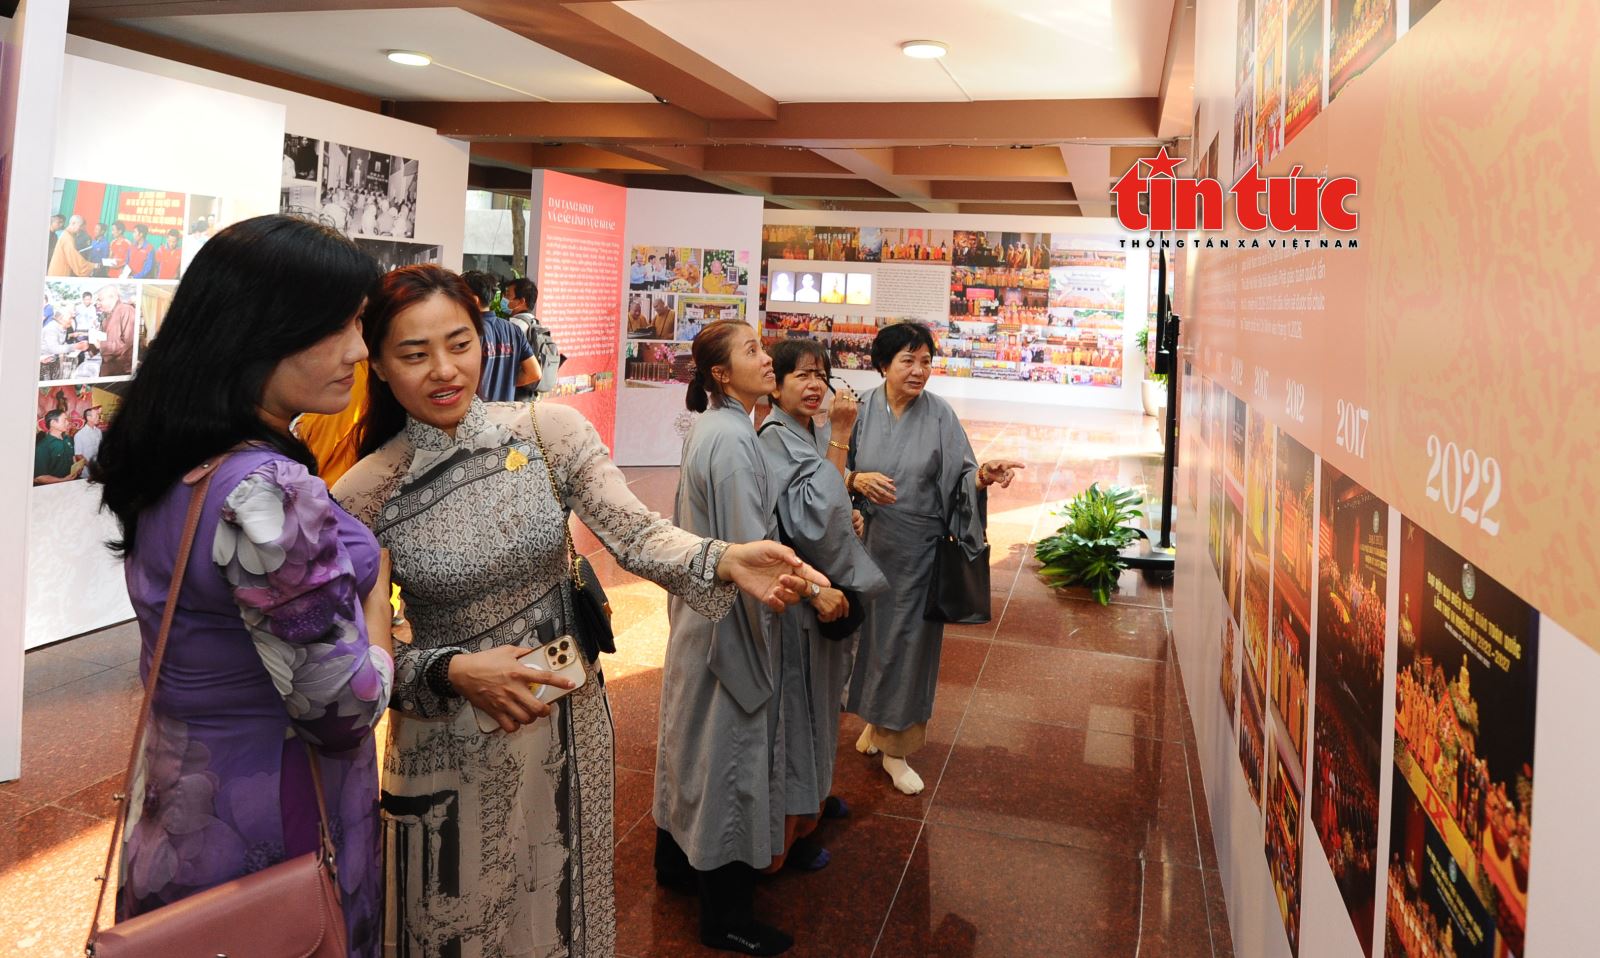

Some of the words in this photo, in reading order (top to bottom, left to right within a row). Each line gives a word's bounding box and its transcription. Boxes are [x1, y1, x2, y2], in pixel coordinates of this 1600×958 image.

[1285, 377, 1305, 423] 2012
[1335, 398, 1369, 459] 2017
[1425, 434, 1502, 537] 2022
